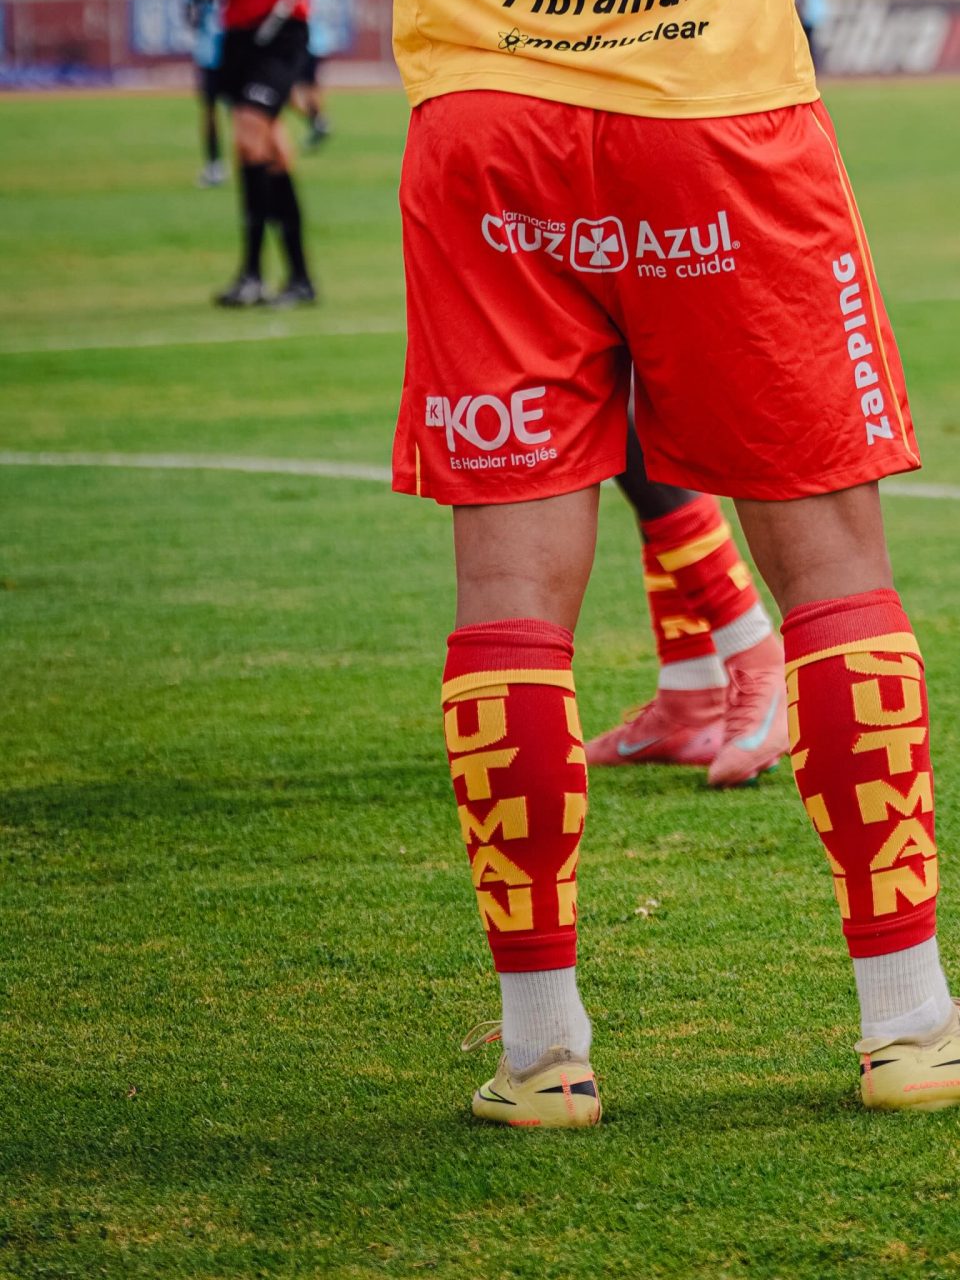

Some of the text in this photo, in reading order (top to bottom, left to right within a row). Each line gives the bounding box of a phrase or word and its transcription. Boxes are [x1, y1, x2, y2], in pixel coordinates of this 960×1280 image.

[526, 20, 709, 52] medinuclear
[502, 209, 566, 232] farmacias
[481, 212, 566, 262] Cruz
[637, 254, 736, 278] me cuida
[442, 386, 552, 452] KOE
[450, 447, 558, 470] Es Hablar Inglés
